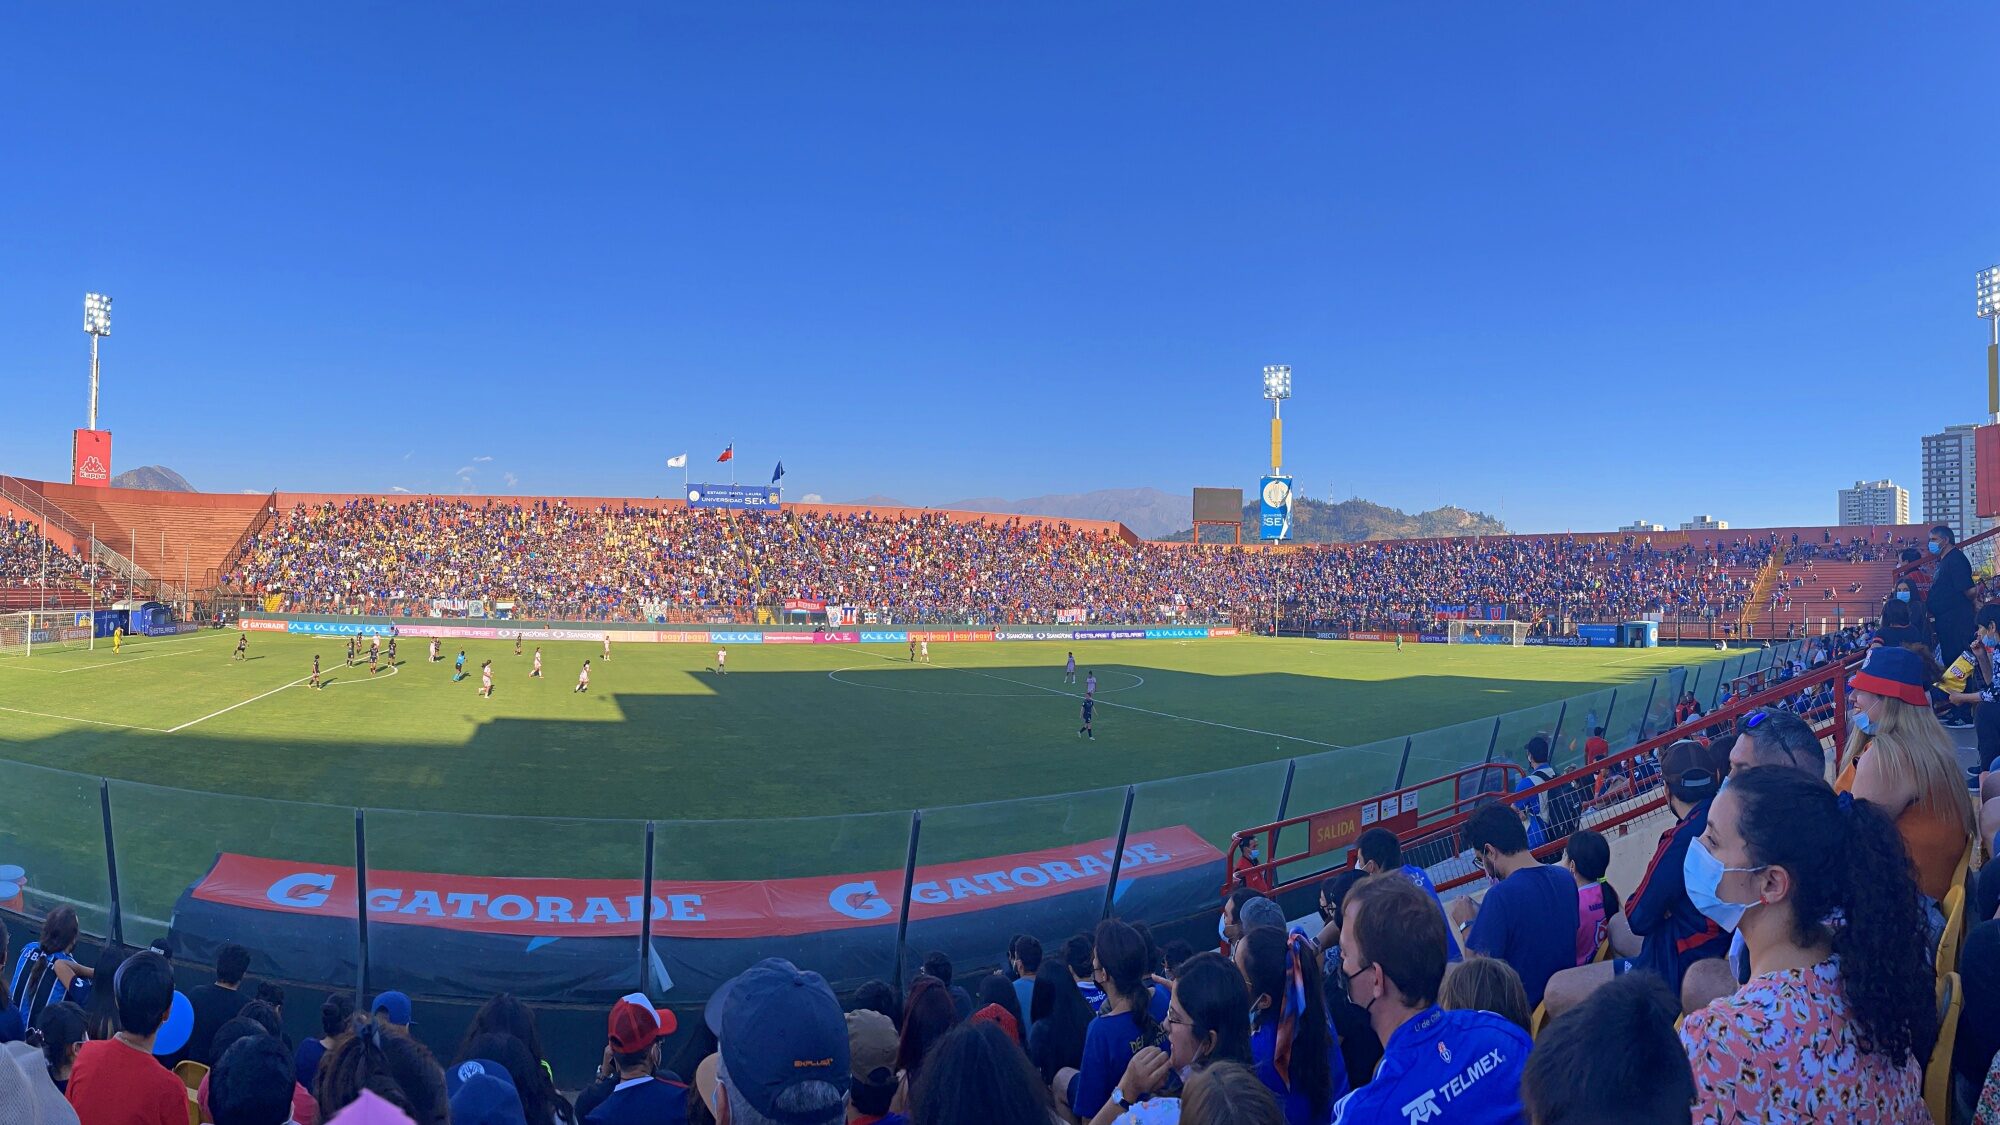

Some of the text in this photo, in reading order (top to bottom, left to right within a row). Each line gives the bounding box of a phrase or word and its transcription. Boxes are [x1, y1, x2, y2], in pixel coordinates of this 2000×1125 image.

[80, 471, 106, 479] Kappa
[744, 497, 767, 505] SEK
[250, 622, 286, 630] GATORADE
[566, 632, 603, 640] SSANGYONG
[1006, 632, 1034, 640] SSANGYONG
[1046, 632, 1073, 640] SSANGYONG
[1317, 819, 1355, 842] SALIDA
[829, 842, 1171, 919] G GATORADE
[266, 873, 707, 923] G GATORADE
[1439, 1048, 1504, 1102] TELMEX
